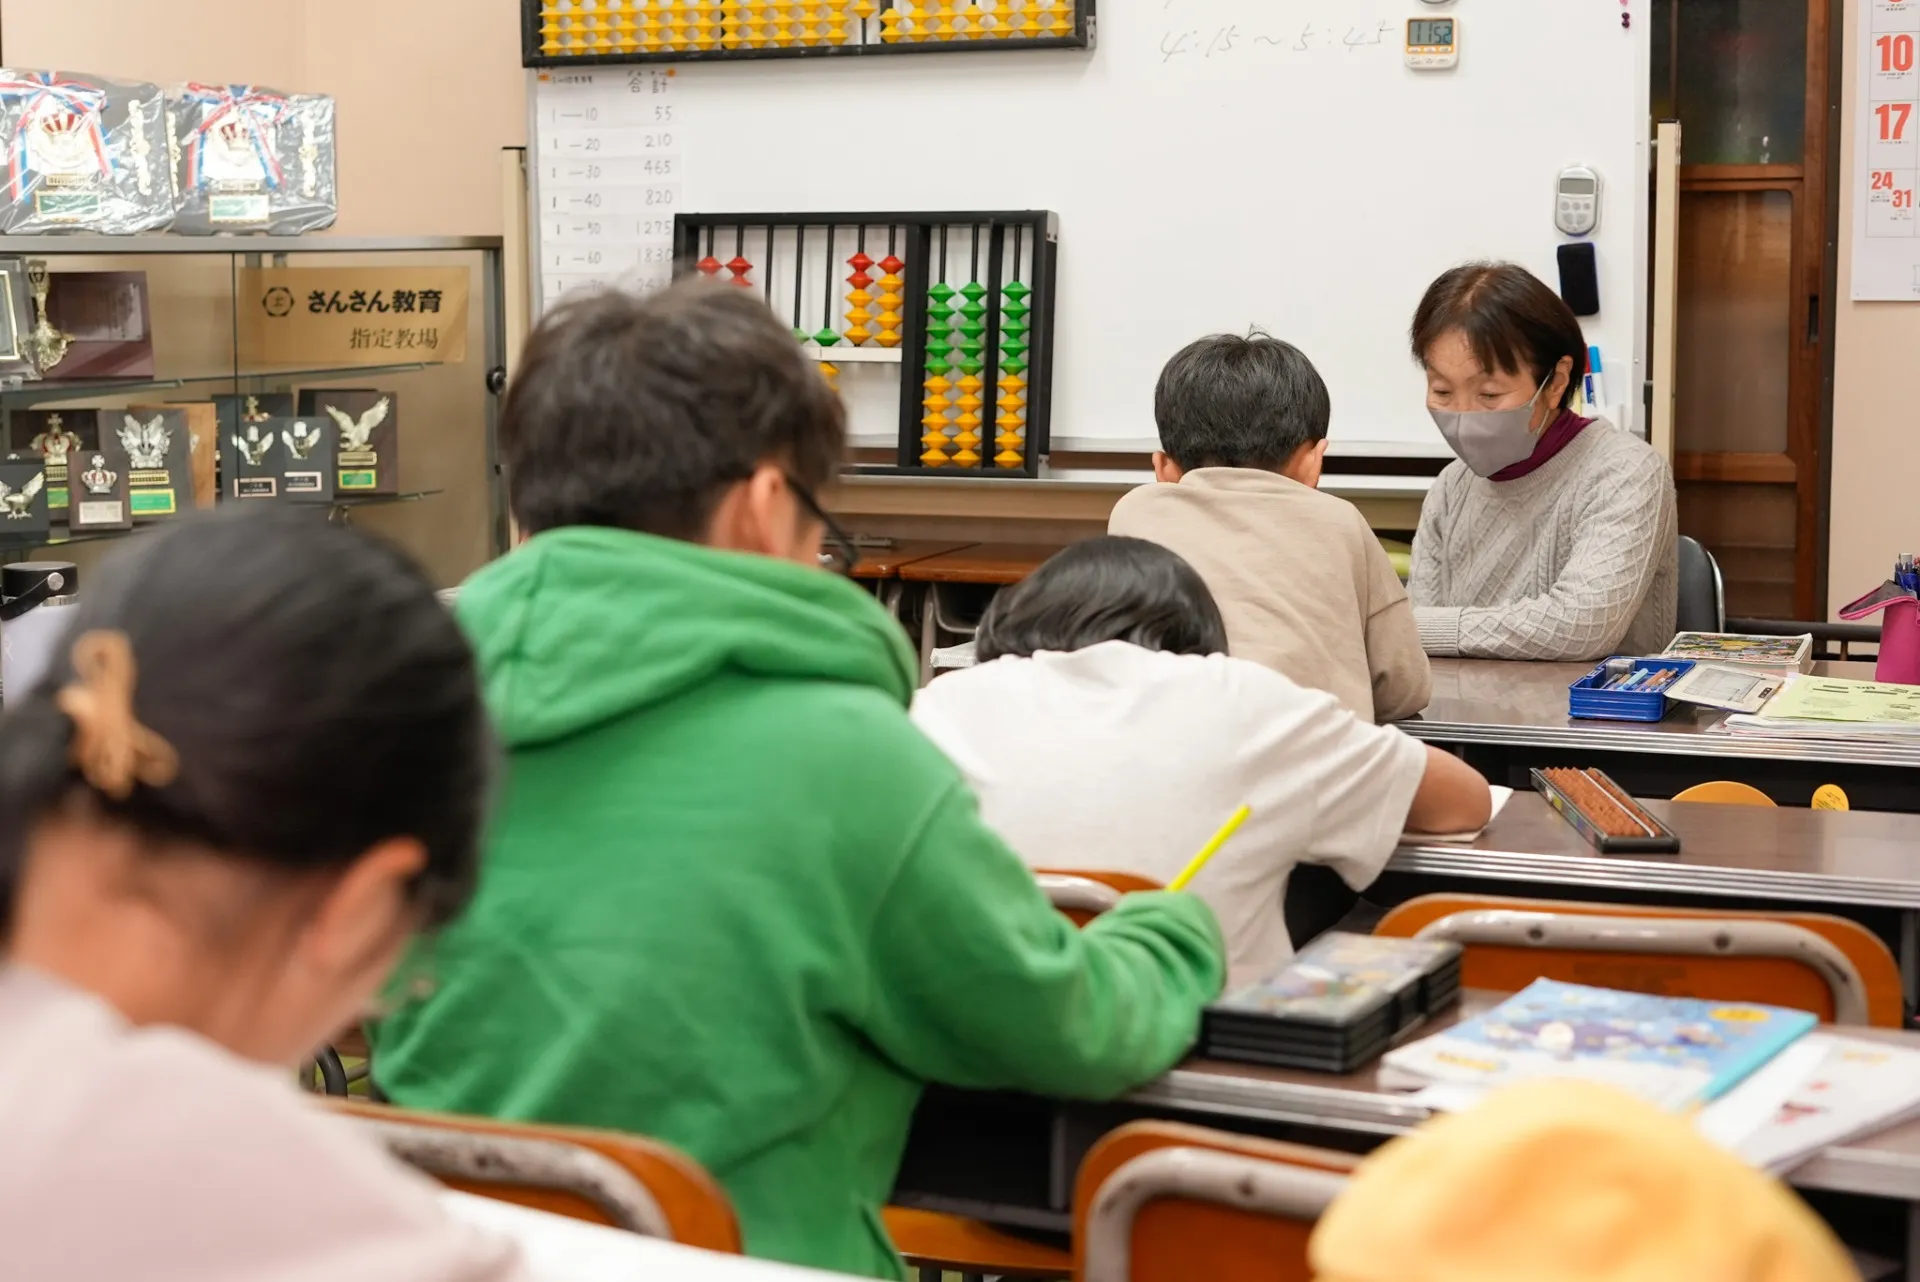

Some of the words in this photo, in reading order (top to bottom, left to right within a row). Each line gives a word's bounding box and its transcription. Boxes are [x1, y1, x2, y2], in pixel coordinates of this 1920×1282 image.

[1876, 34, 1913, 71] 10
[654, 105, 673, 121] 55
[1875, 103, 1912, 140] 17
[645, 133, 673, 148] 210
[644, 160, 672, 175] 465
[1871, 171, 1893, 190] 24
[645, 189, 673, 206] 820
[1892, 189, 1912, 208] 31
[636, 220, 673, 236] 1275
[308, 290, 442, 313] さんさん教育
[349, 328, 438, 350] 指定教場
